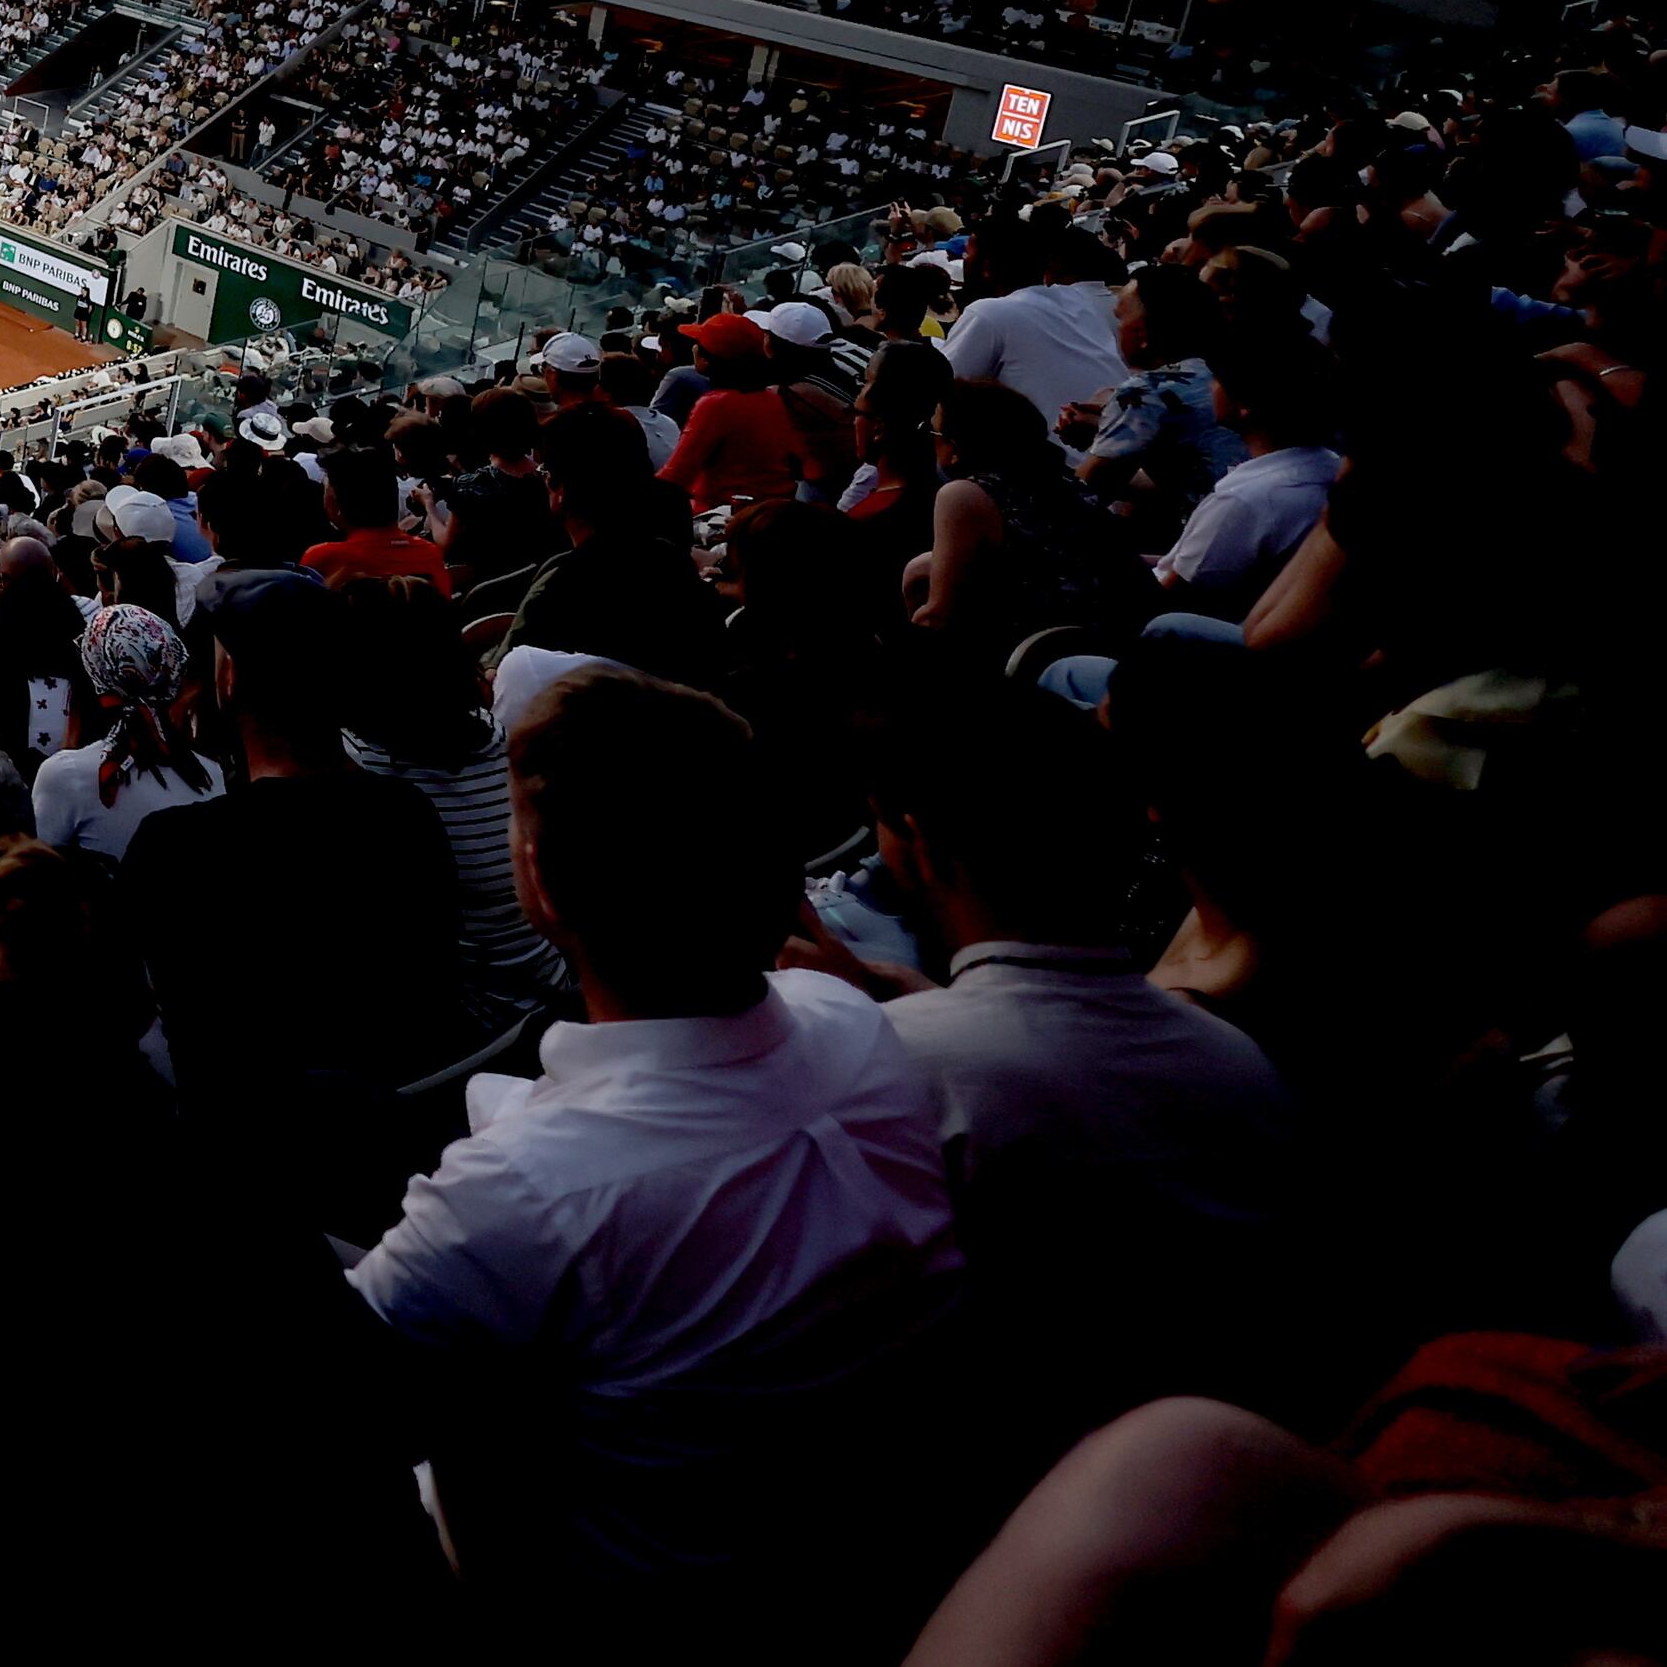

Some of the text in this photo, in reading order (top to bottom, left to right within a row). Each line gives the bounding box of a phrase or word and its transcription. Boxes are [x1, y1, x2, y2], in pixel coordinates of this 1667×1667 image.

[1009, 94, 1040, 115] TEN
[1002, 120, 1034, 140] NIS
[19, 253, 88, 288] BNP PARIBAS
[188, 235, 267, 281] Emirates
[2, 280, 21, 296] BNP
[21, 289, 60, 312] PARIBAS
[302, 278, 389, 325] Emirates
